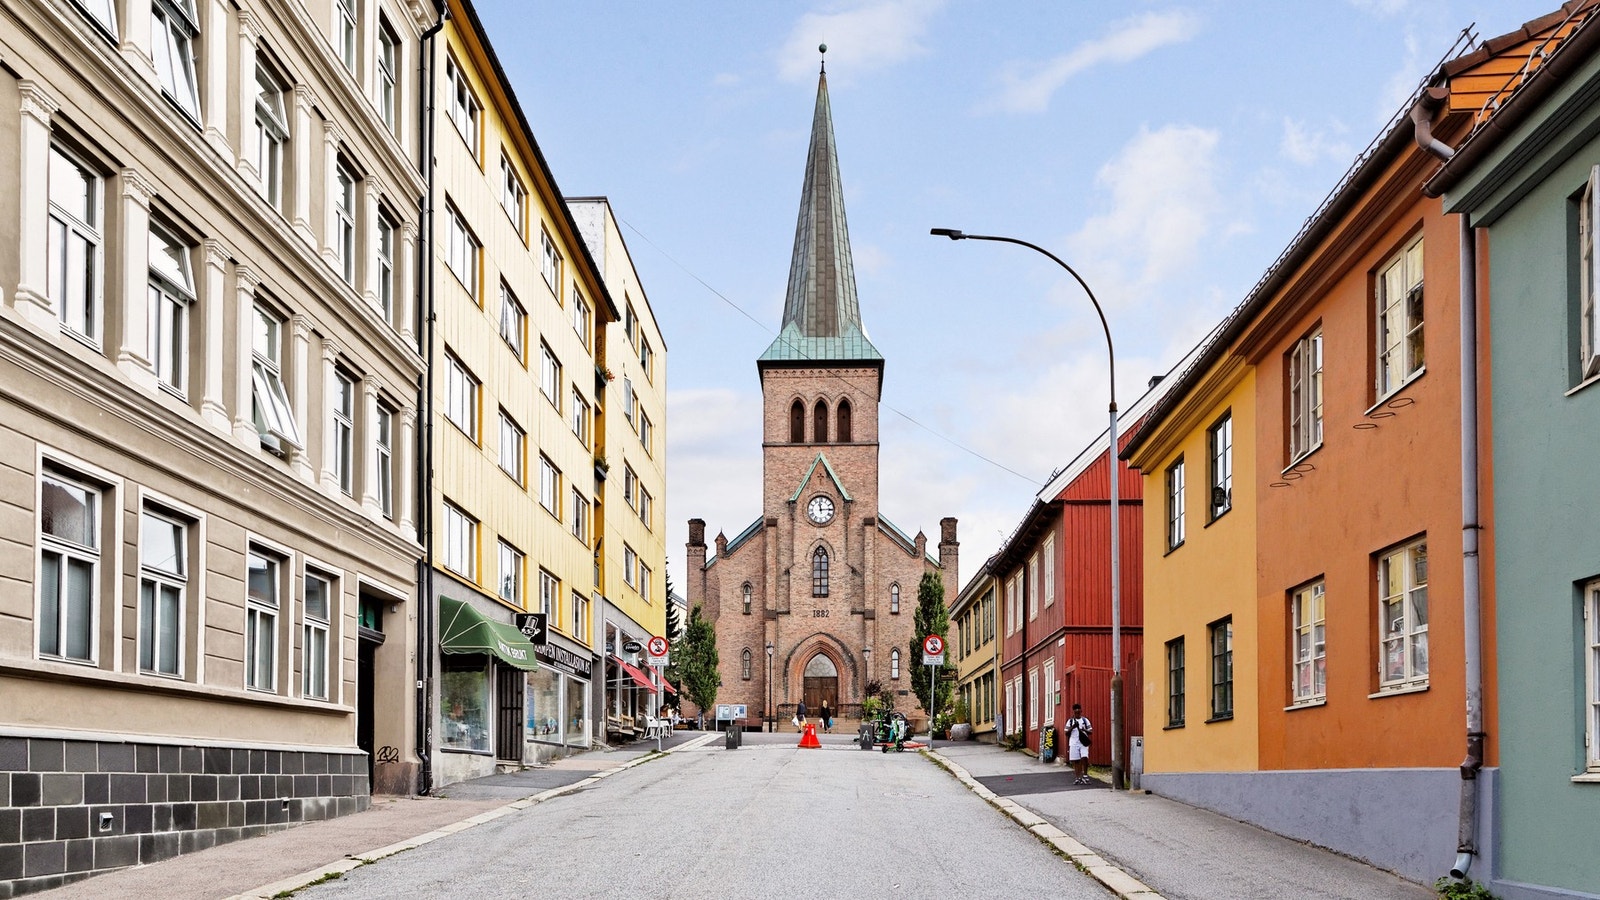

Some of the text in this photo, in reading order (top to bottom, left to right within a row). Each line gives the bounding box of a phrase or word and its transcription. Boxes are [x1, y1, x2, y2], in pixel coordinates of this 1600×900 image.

[813, 609, 830, 618] 1882
[556, 647, 585, 672] INSTALLASJON
[585, 661, 590, 674] AS
